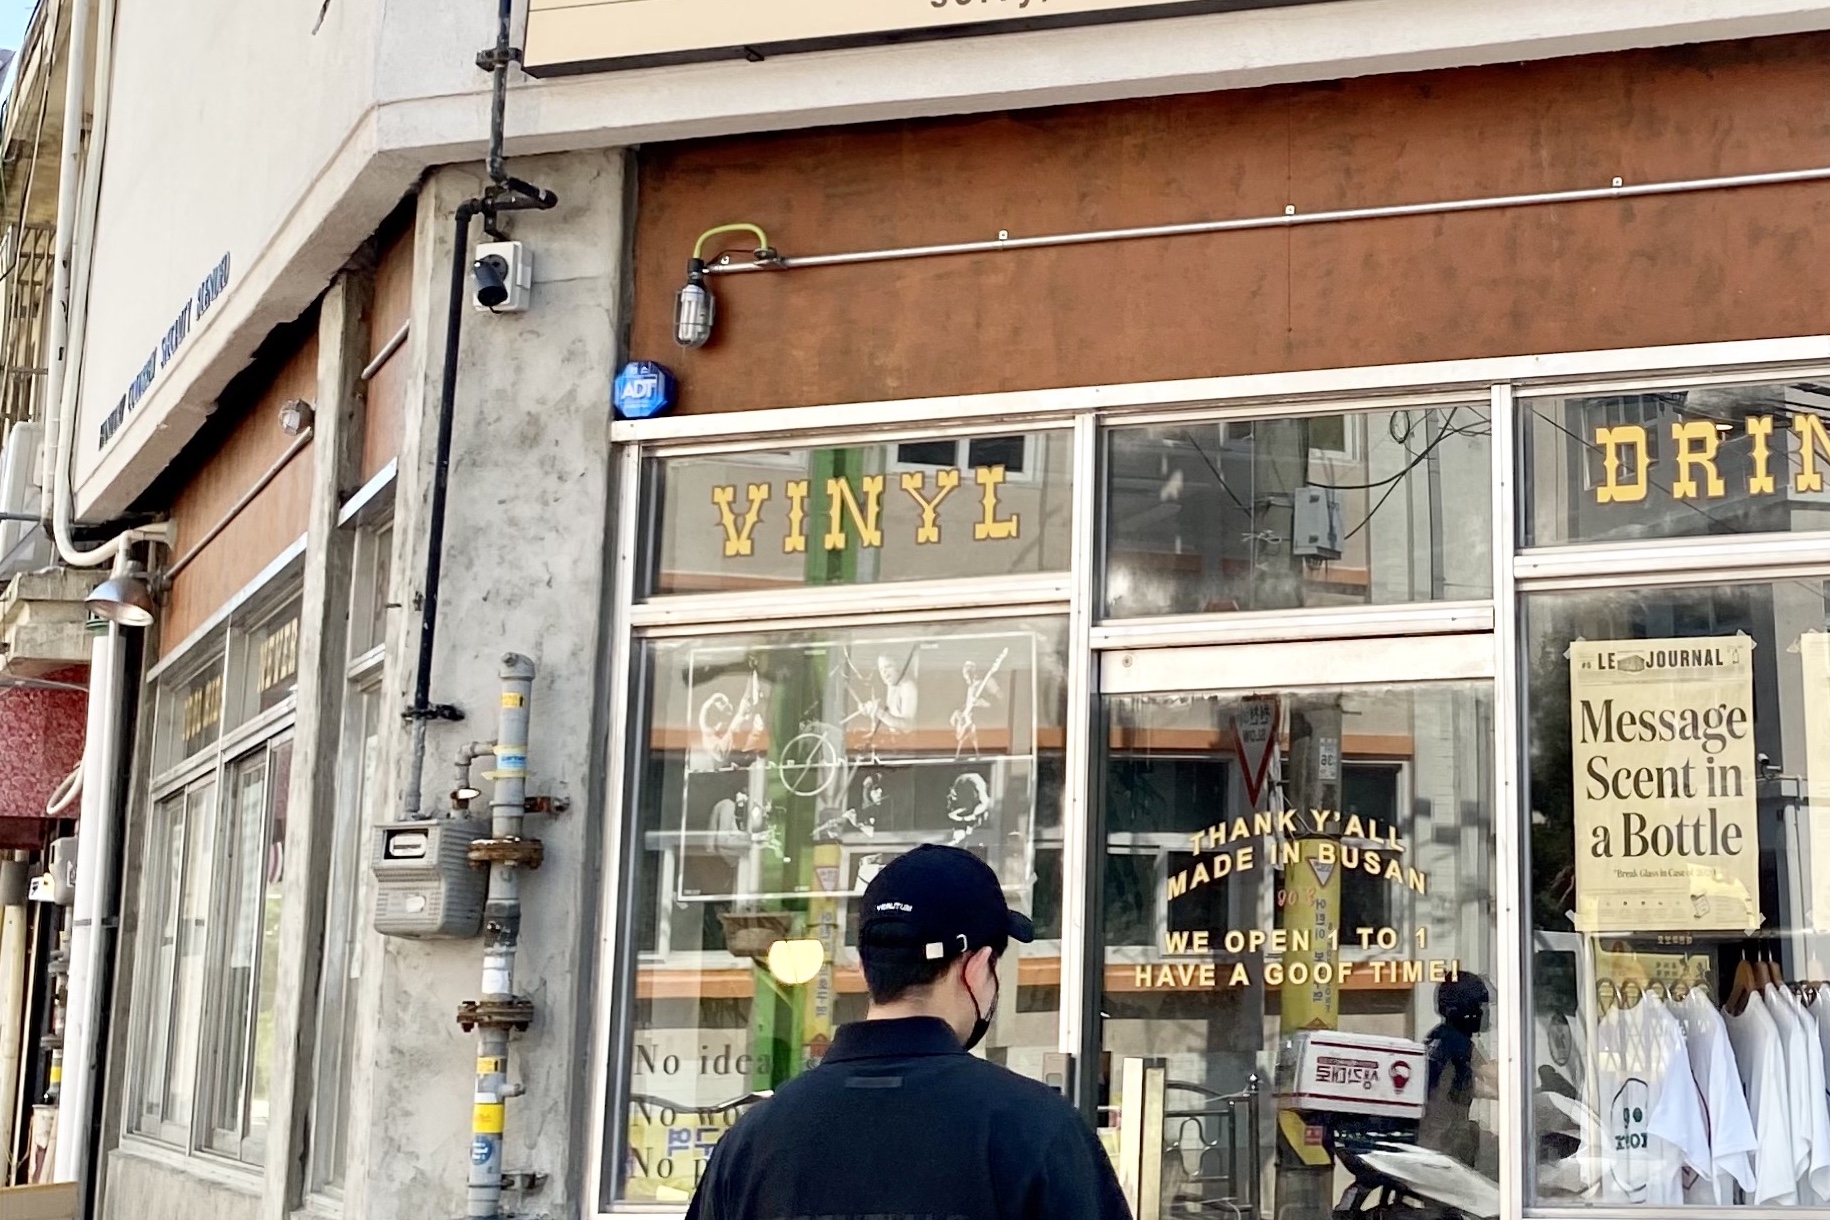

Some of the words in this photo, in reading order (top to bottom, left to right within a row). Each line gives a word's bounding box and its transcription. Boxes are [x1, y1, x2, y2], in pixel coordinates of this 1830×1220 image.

[621, 379, 657, 400] ADT
[1596, 413, 1830, 503] DRIN
[712, 465, 1019, 557] VINYL
[1598, 653, 1616, 670] LE
[1646, 648, 1723, 668] JOURNAL
[1580, 699, 1748, 755] Message
[1586, 755, 1698, 800] Scent
[1706, 757, 1744, 798] in
[1189, 809, 1298, 856] THANK
[1591, 824, 1613, 858] a
[1622, 808, 1744, 858] Bottle
[1167, 846, 1255, 901] MADE
[1271, 842, 1300, 865] IN
[1318, 843, 1427, 895] BUSAN
[1640, 868, 1659, 877] Glass
[1660, 868, 1667, 877] in
[1668, 868, 1685, 877] Case
[1165, 930, 1210, 955] WE
[1225, 929, 1310, 954] OPEN
[1327, 928, 1339, 951] 1
[1356, 927, 1398, 951] TO
[1415, 927, 1427, 949] 1
[1135, 962, 1216, 987] HAVE
[1229, 962, 1250, 986] A
[1264, 961, 1353, 985] GOOF
[1370, 959, 1460, 984] TIME!
[634, 1044, 680, 1075] No
[631, 1098, 677, 1127] No
[629, 1147, 673, 1178] No
